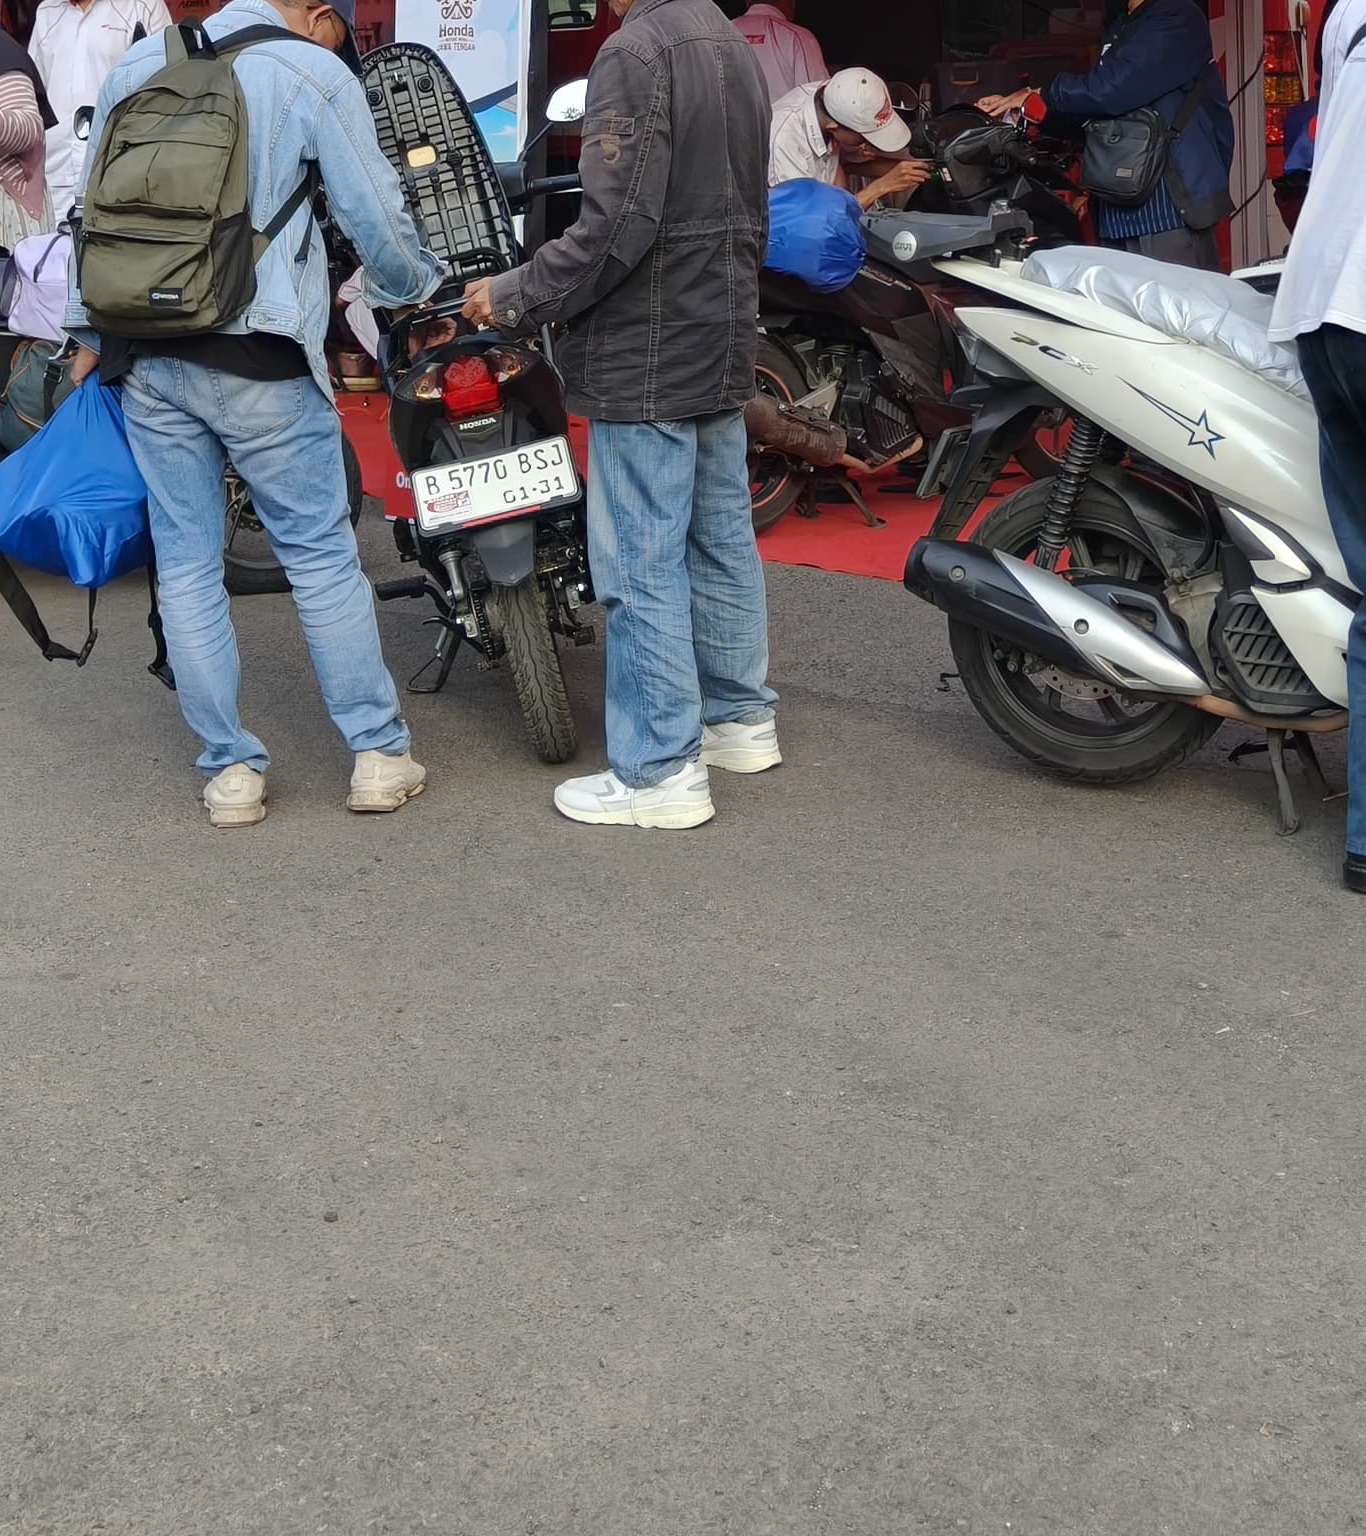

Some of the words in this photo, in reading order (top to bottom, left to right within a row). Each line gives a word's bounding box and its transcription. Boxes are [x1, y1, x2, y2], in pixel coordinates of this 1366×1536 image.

[438, 24, 474, 38] Honda
[894, 242, 913, 252] GIVI
[459, 417, 497, 431] HONDA
[425, 475, 441, 496] B
[448, 458, 508, 490] 5770
[517, 444, 564, 475] BSJ
